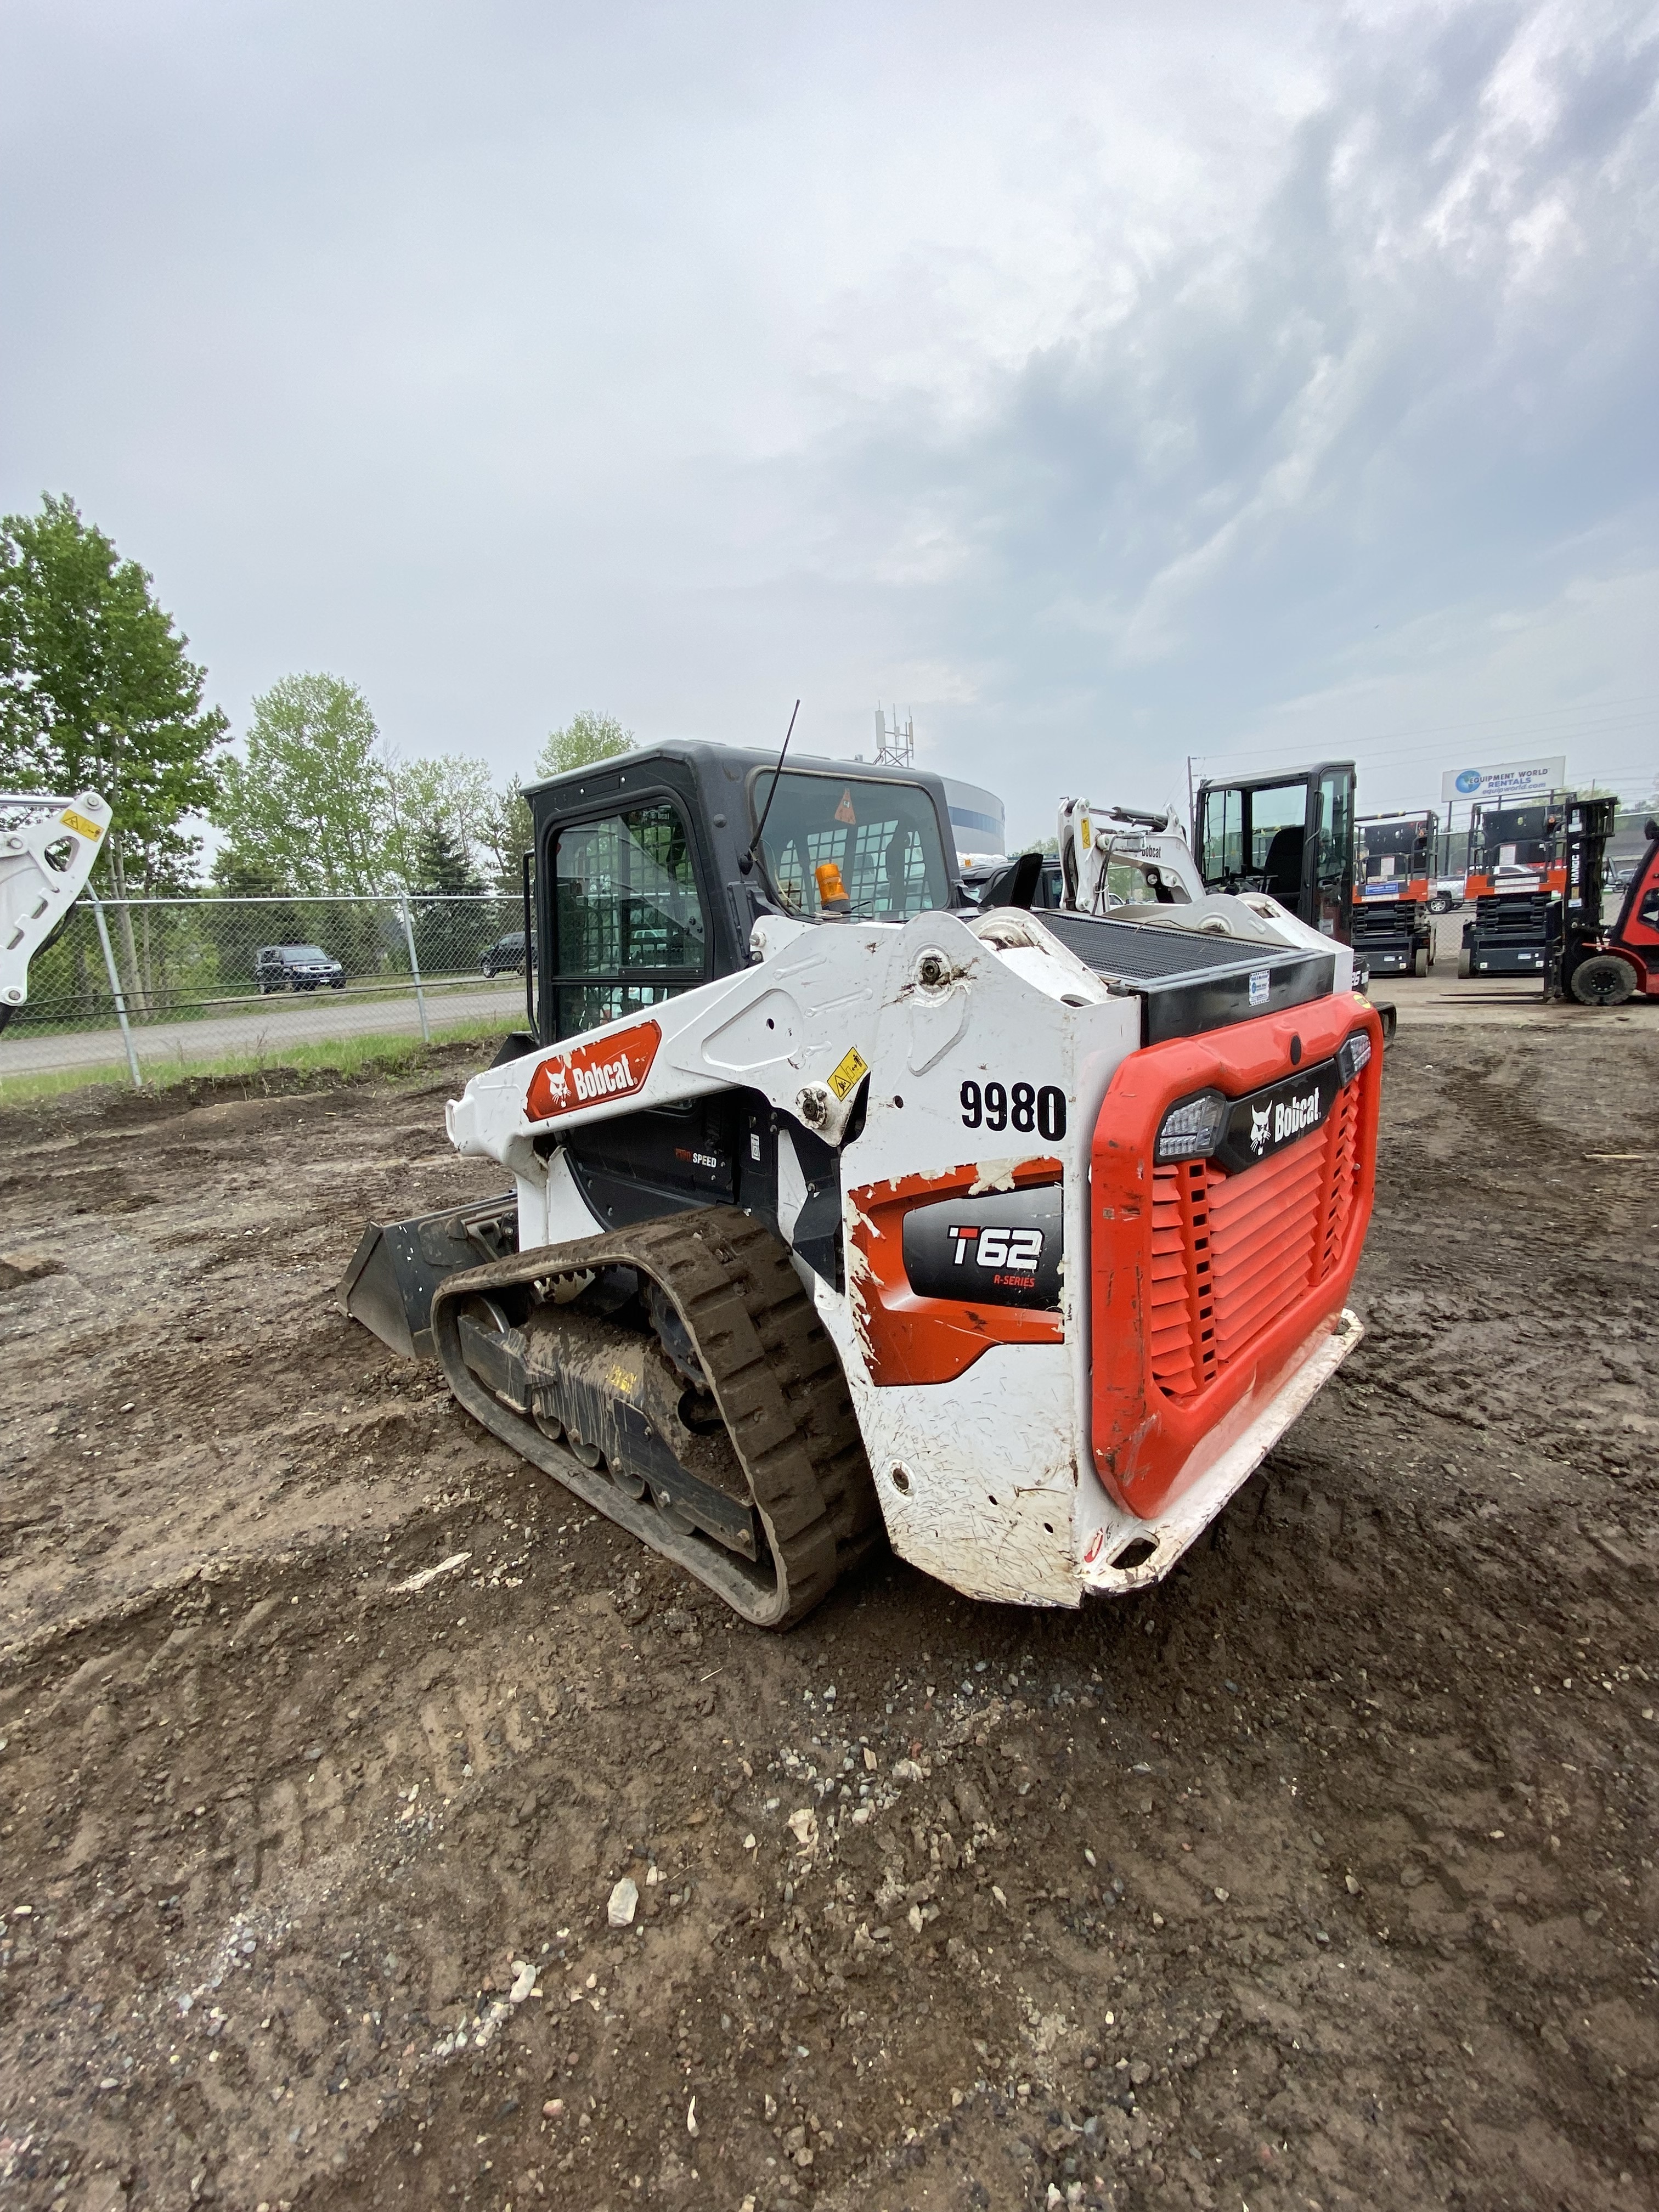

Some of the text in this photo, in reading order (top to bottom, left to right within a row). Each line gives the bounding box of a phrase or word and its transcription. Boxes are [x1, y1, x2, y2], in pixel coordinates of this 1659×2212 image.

[1470, 768, 1548, 784] EQUIPMENT WORLD
[1488, 777, 1532, 788] RENTALS
[1482, 782, 1547, 795] equipworld.com
[572, 1053, 634, 1101] Bobcat
[960, 1080, 1066, 1142] 9980
[1274, 1087, 1319, 1143] Bobcat
[692, 1153, 716, 1168] SPEED
[948, 1226, 1043, 1271] T62
[994, 1274, 1035, 1288] R-SERIES
